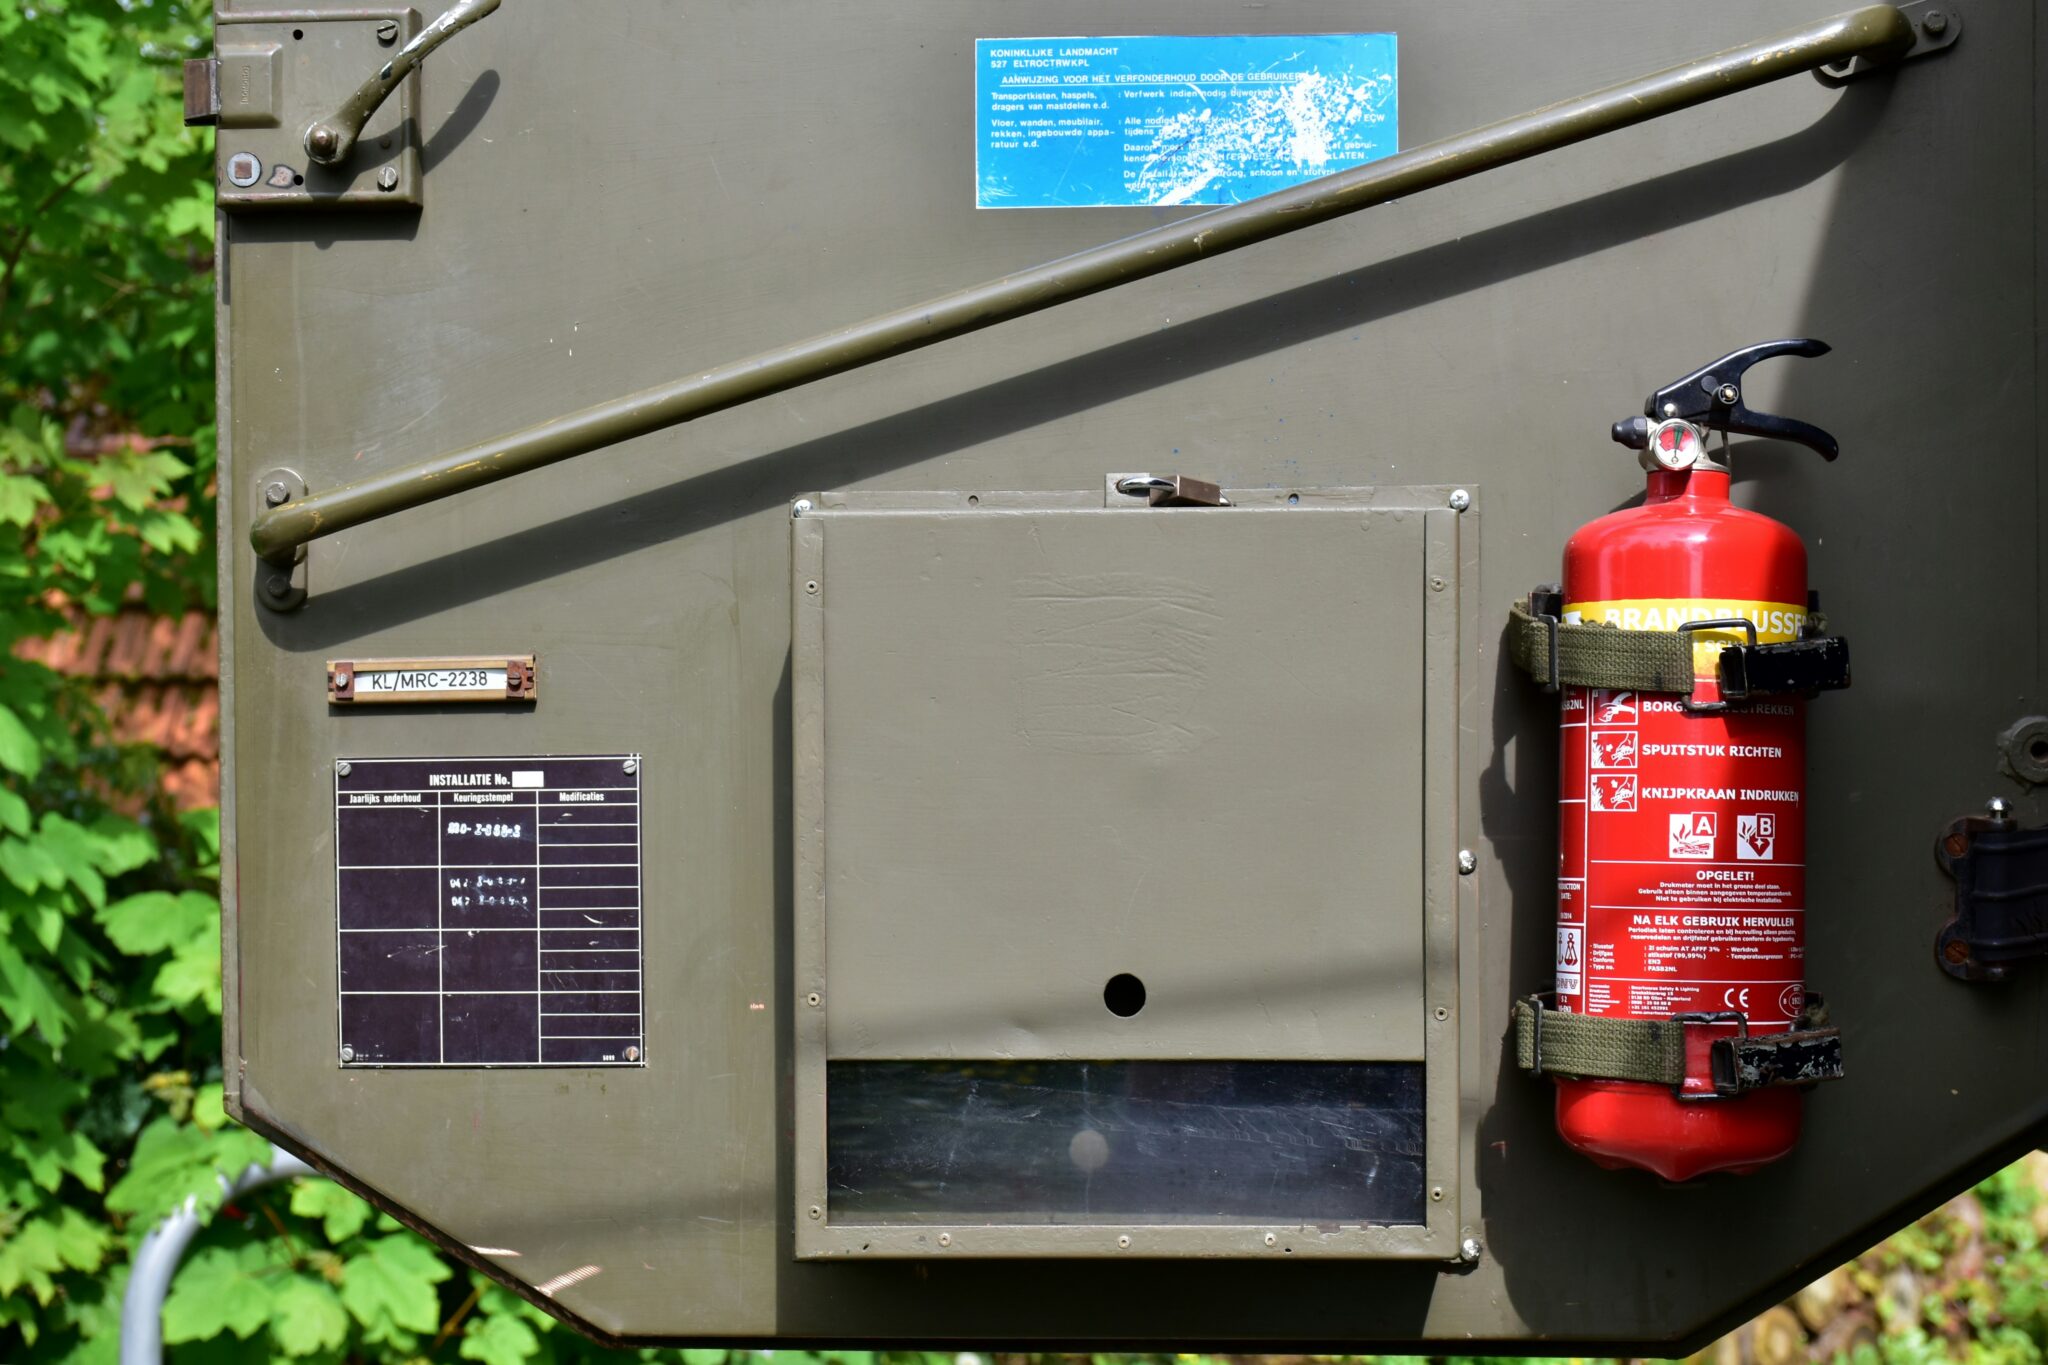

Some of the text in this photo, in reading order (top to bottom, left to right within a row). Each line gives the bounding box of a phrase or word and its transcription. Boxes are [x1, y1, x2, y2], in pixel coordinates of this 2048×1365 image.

[990, 47, 1119, 58] KONINKLIJKE LANDMACHT
[990, 60, 1008, 68] 527
[1001, 75, 1059, 84] AANWIJZING
[1063, 74, 1089, 83] VOOR
[1092, 74, 1111, 83] HET
[1114, 73, 1197, 82] VERFONDERHOUD
[1200, 73, 1229, 81] DOOR
[1231, 72, 1245, 81] DE
[991, 91, 1097, 101] Transportkisten, haspels,
[1124, 89, 1165, 98] Verfwerk
[1170, 89, 1198, 98] indien
[991, 101, 1110, 112] dragers van mastdelen e.d.
[991, 119, 1018, 128] Vloer,
[1124, 116, 1142, 125] Alle
[1363, 114, 1386, 122] ECW
[1028, 128, 1083, 138] ingebouwde
[1087, 129, 1116, 138] appa-
[1124, 127, 1155, 137] tijdens
[991, 139, 1040, 149] ratuur e.d.
[1123, 170, 1136, 179] De
[1249, 168, 1286, 177] schoon
[1286, 169, 1298, 177] en
[372, 670, 488, 692] KL/MRC-2238
[1642, 744, 1783, 759] SPUITSTUK RICHTEN
[429, 773, 511, 787] INSTALLATIE No.
[349, 793, 422, 805] Jaarlijks onderhoud
[453, 792, 514, 804] Keuringsstempel
[559, 791, 605, 802] Modificaties
[1642, 787, 1799, 803] KNIJPKRAAN INDRUKKEN
[1695, 816, 1713, 835] A
[1760, 817, 1772, 836] B
[1696, 869, 1755, 881] OPGELET!
[1659, 881, 1695, 889] Drukmeter
[1696, 882, 1714, 890] moet
[1714, 882, 1721, 890] in
[1664, 888, 1685, 896] alleen
[1685, 889, 1709, 897] binnen
[1709, 890, 1747, 898] aangegeven
[1655, 895, 1669, 903] Niet
[1679, 895, 1713, 904] gebruiken
[1713, 896, 1723, 905] bij
[1723, 896, 1756, 904] elektrische
[1633, 914, 1795, 928] NA ELK GEBRUIK HERVULLEN
[1658, 927, 1676, 935] laten
[1677, 928, 1715, 936] controleren
[1725, 929, 1735, 938] bij
[1710, 935, 1742, 944] gebruiken
